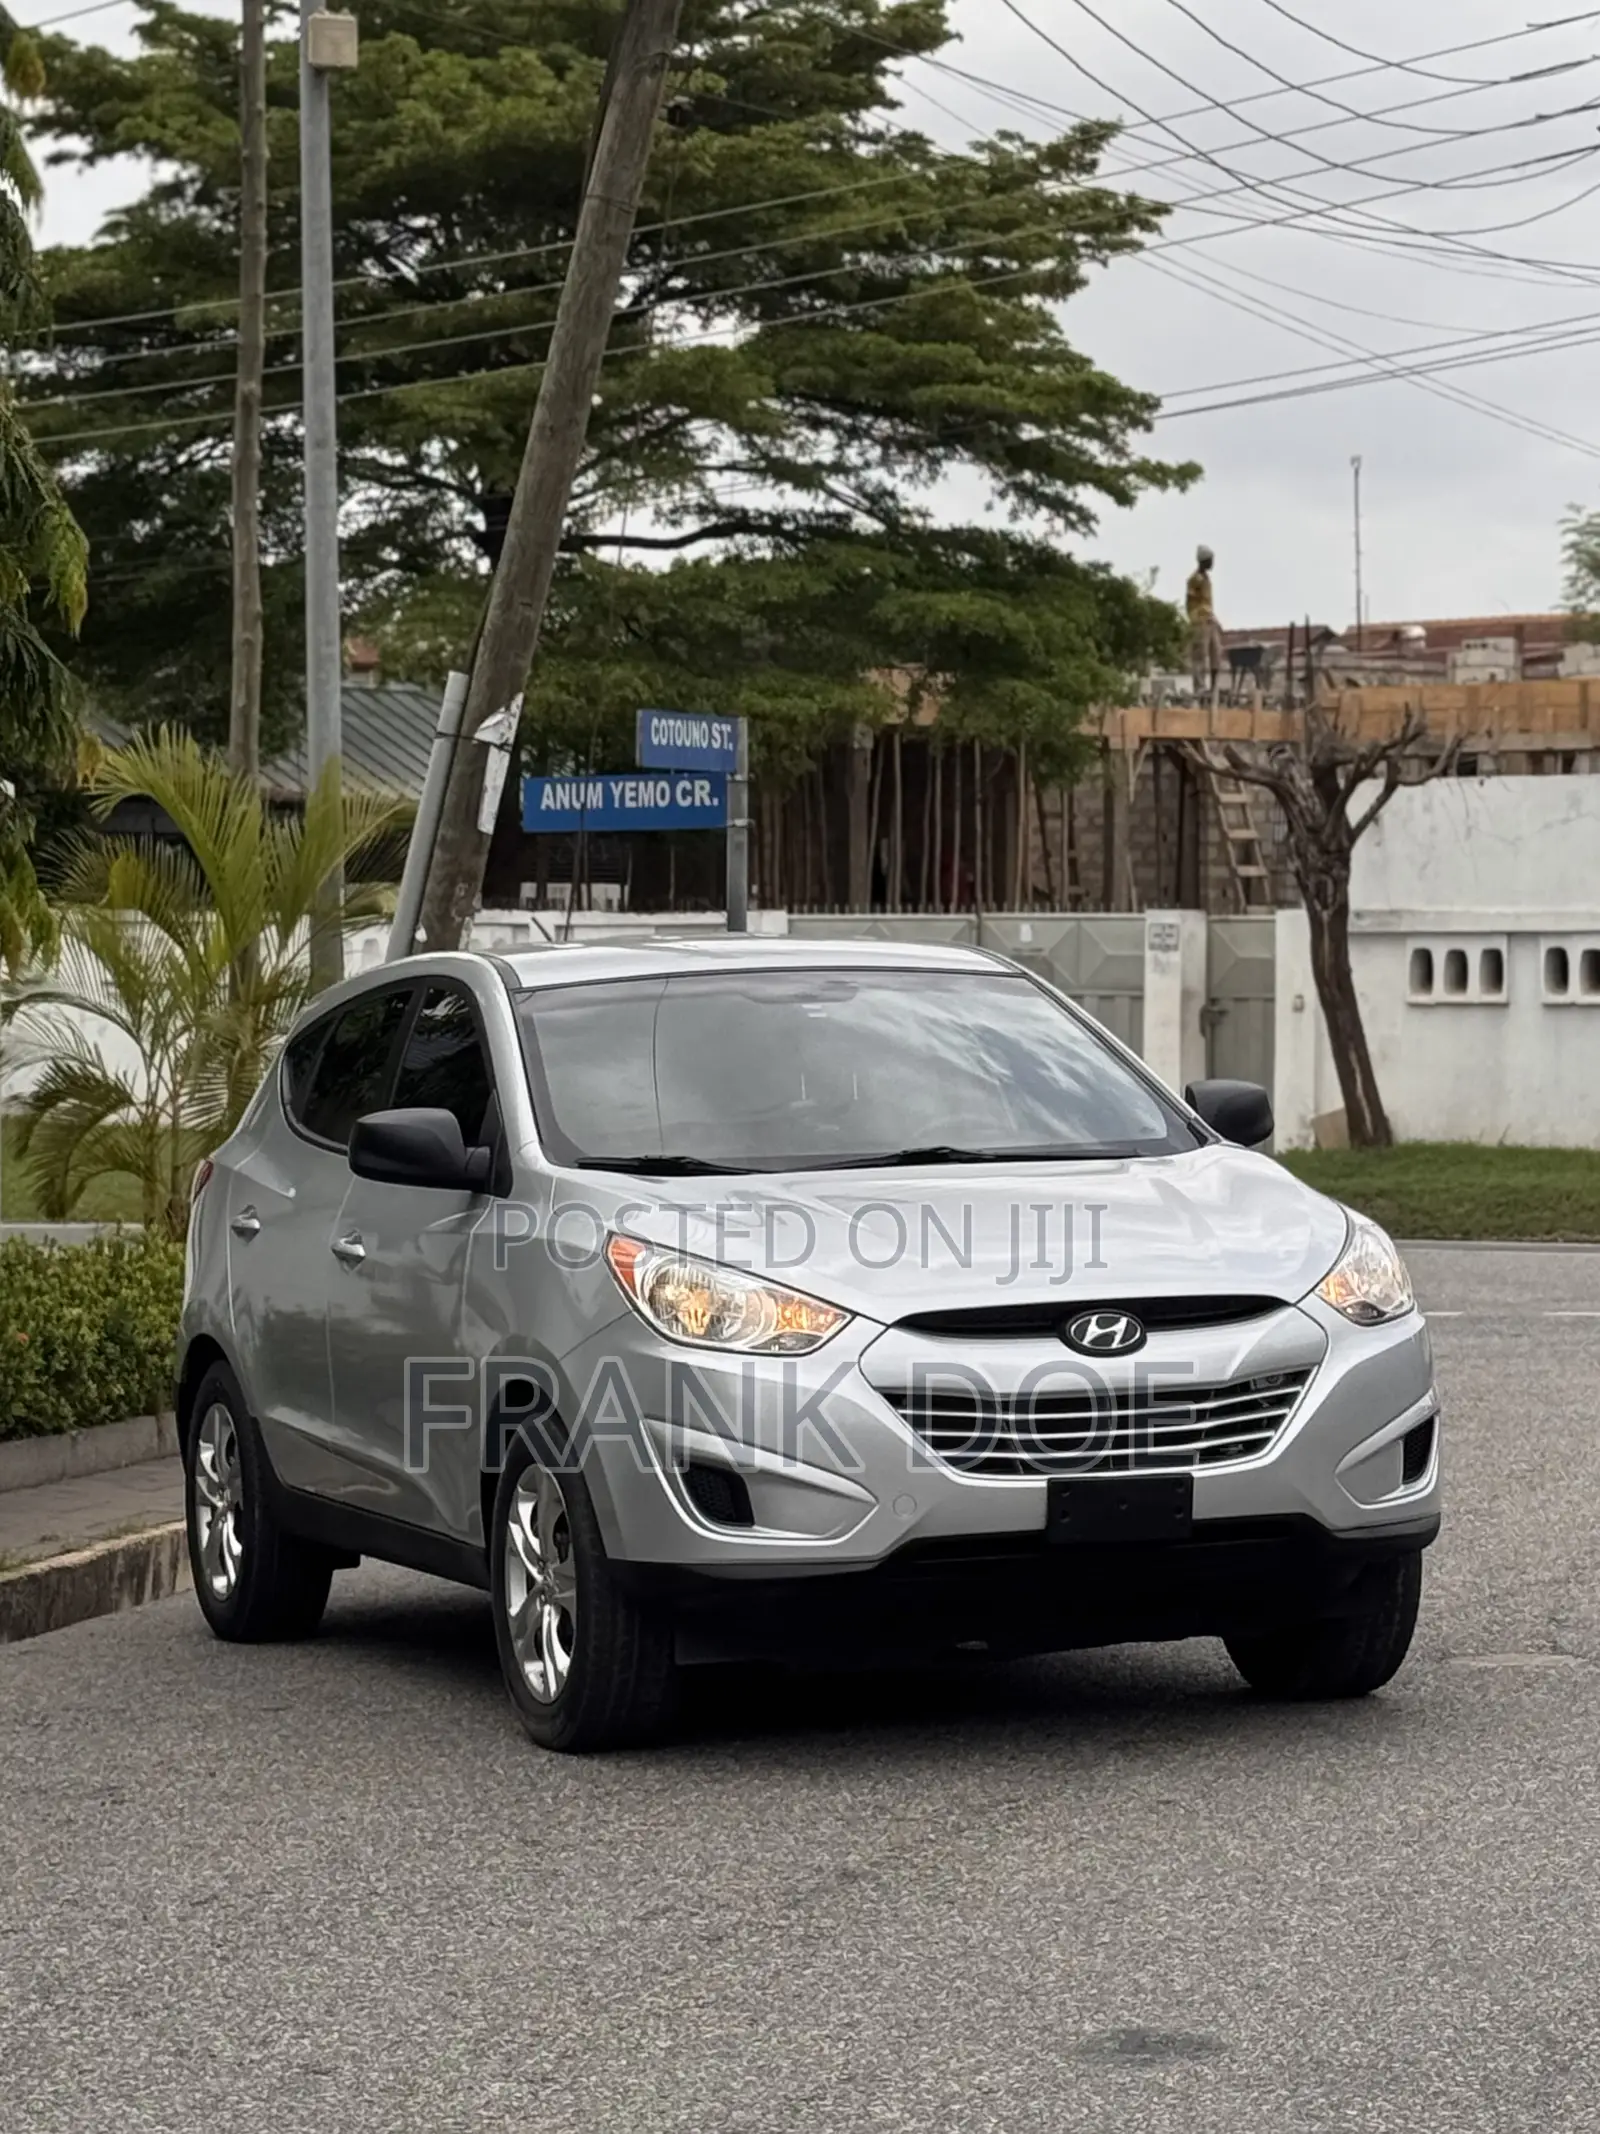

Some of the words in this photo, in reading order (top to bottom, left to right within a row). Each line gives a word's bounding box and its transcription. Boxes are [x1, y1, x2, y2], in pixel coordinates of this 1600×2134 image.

[651, 716, 709, 748] COTOUNO
[711, 722, 734, 751] ST.
[540, 781, 603, 811] ANUM
[609, 780, 670, 809] YEMO
[675, 779, 719, 808] CR.
